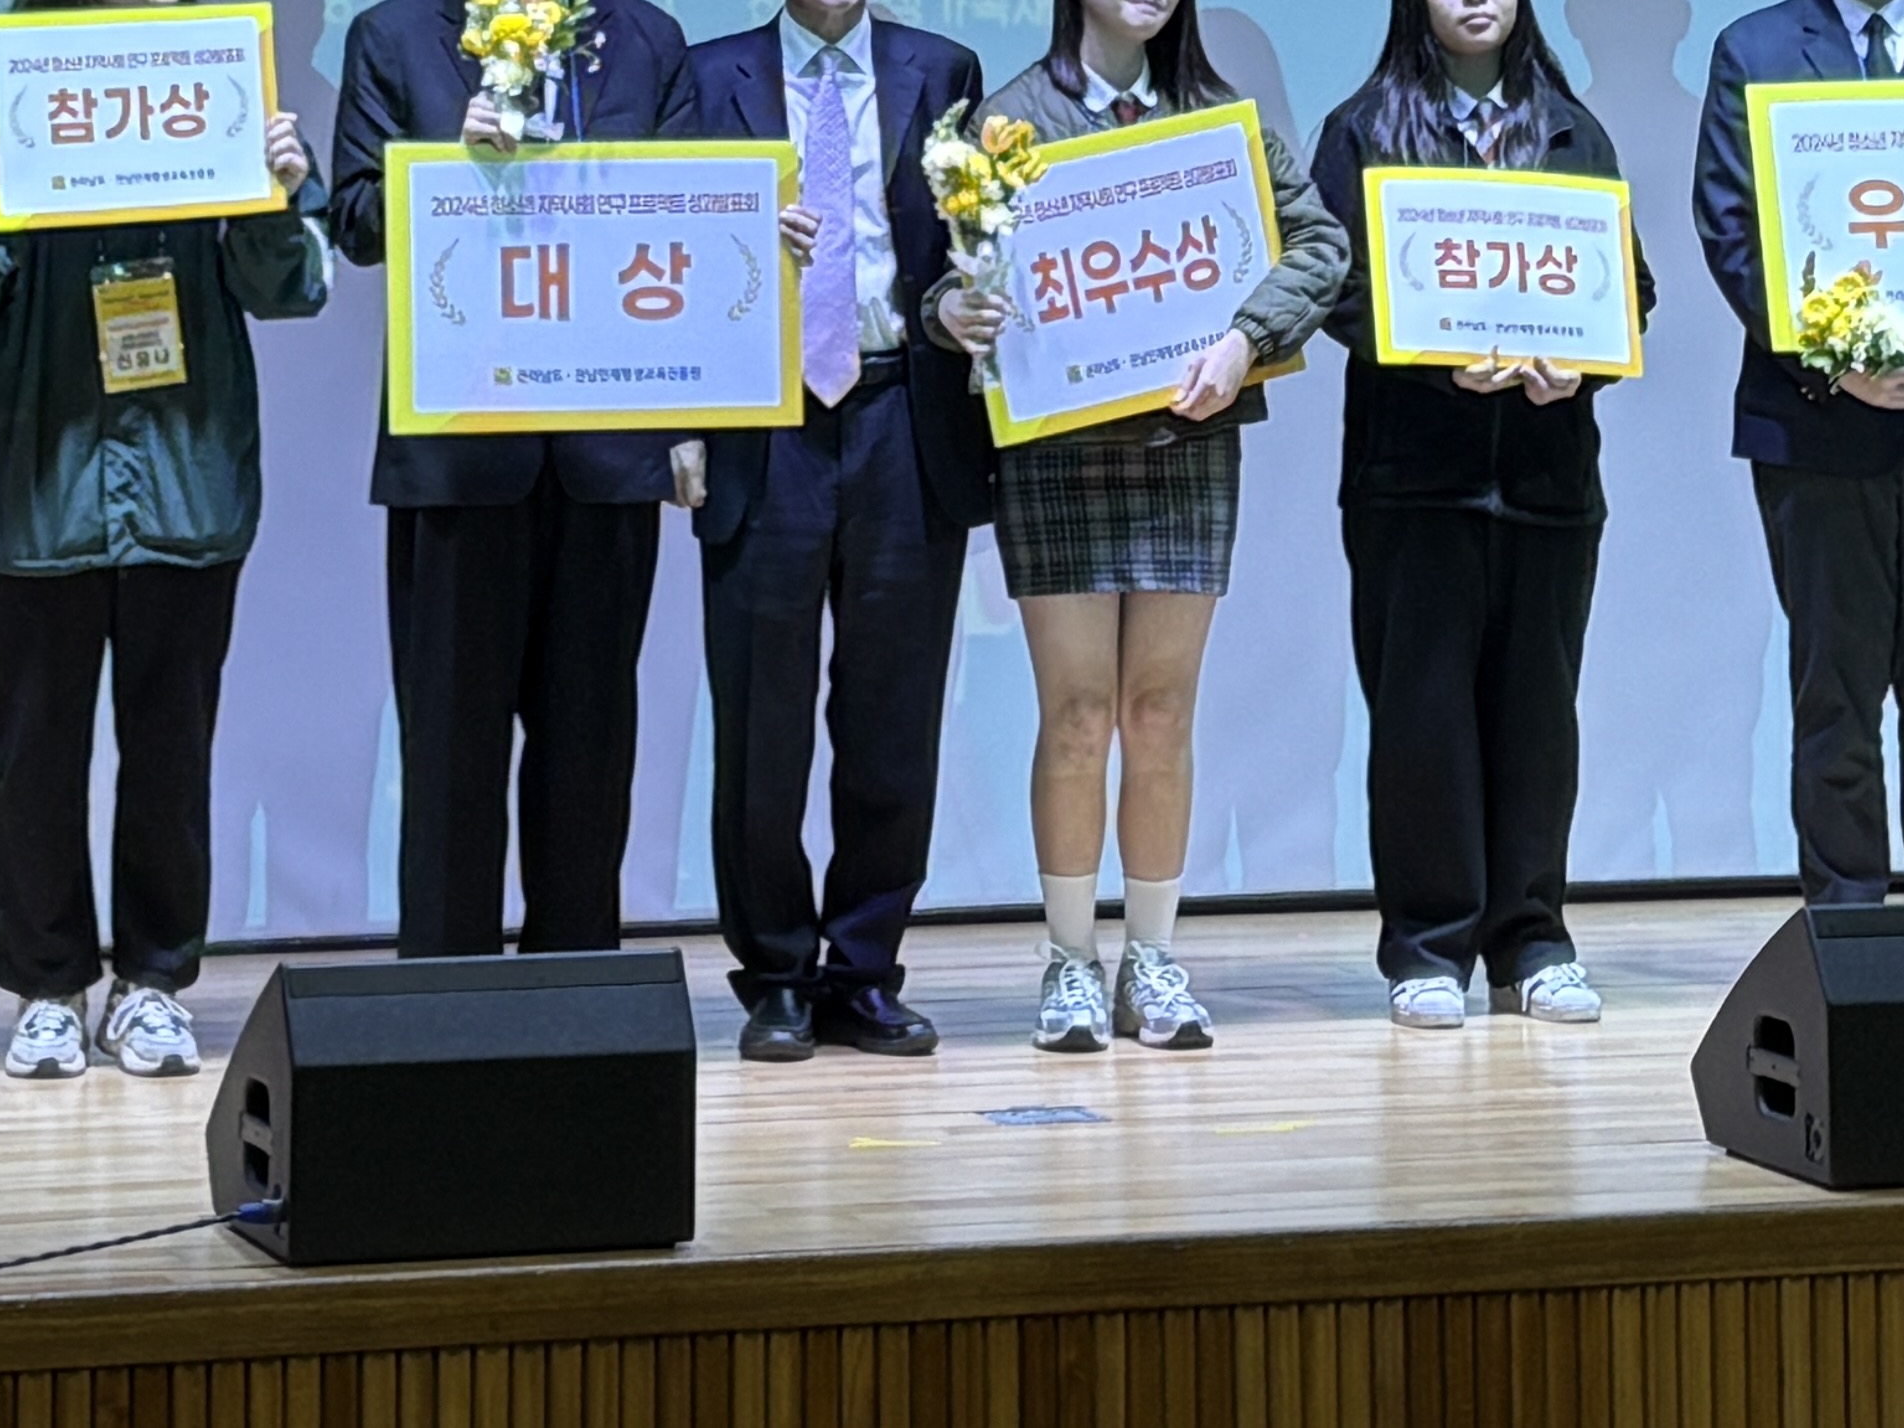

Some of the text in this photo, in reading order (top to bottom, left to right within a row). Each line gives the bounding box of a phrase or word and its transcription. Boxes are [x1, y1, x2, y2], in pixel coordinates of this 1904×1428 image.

[48, 82, 209, 144] 참가상
[1030, 214, 1221, 323] 최우수상
[1435, 238, 1577, 295] 참가상
